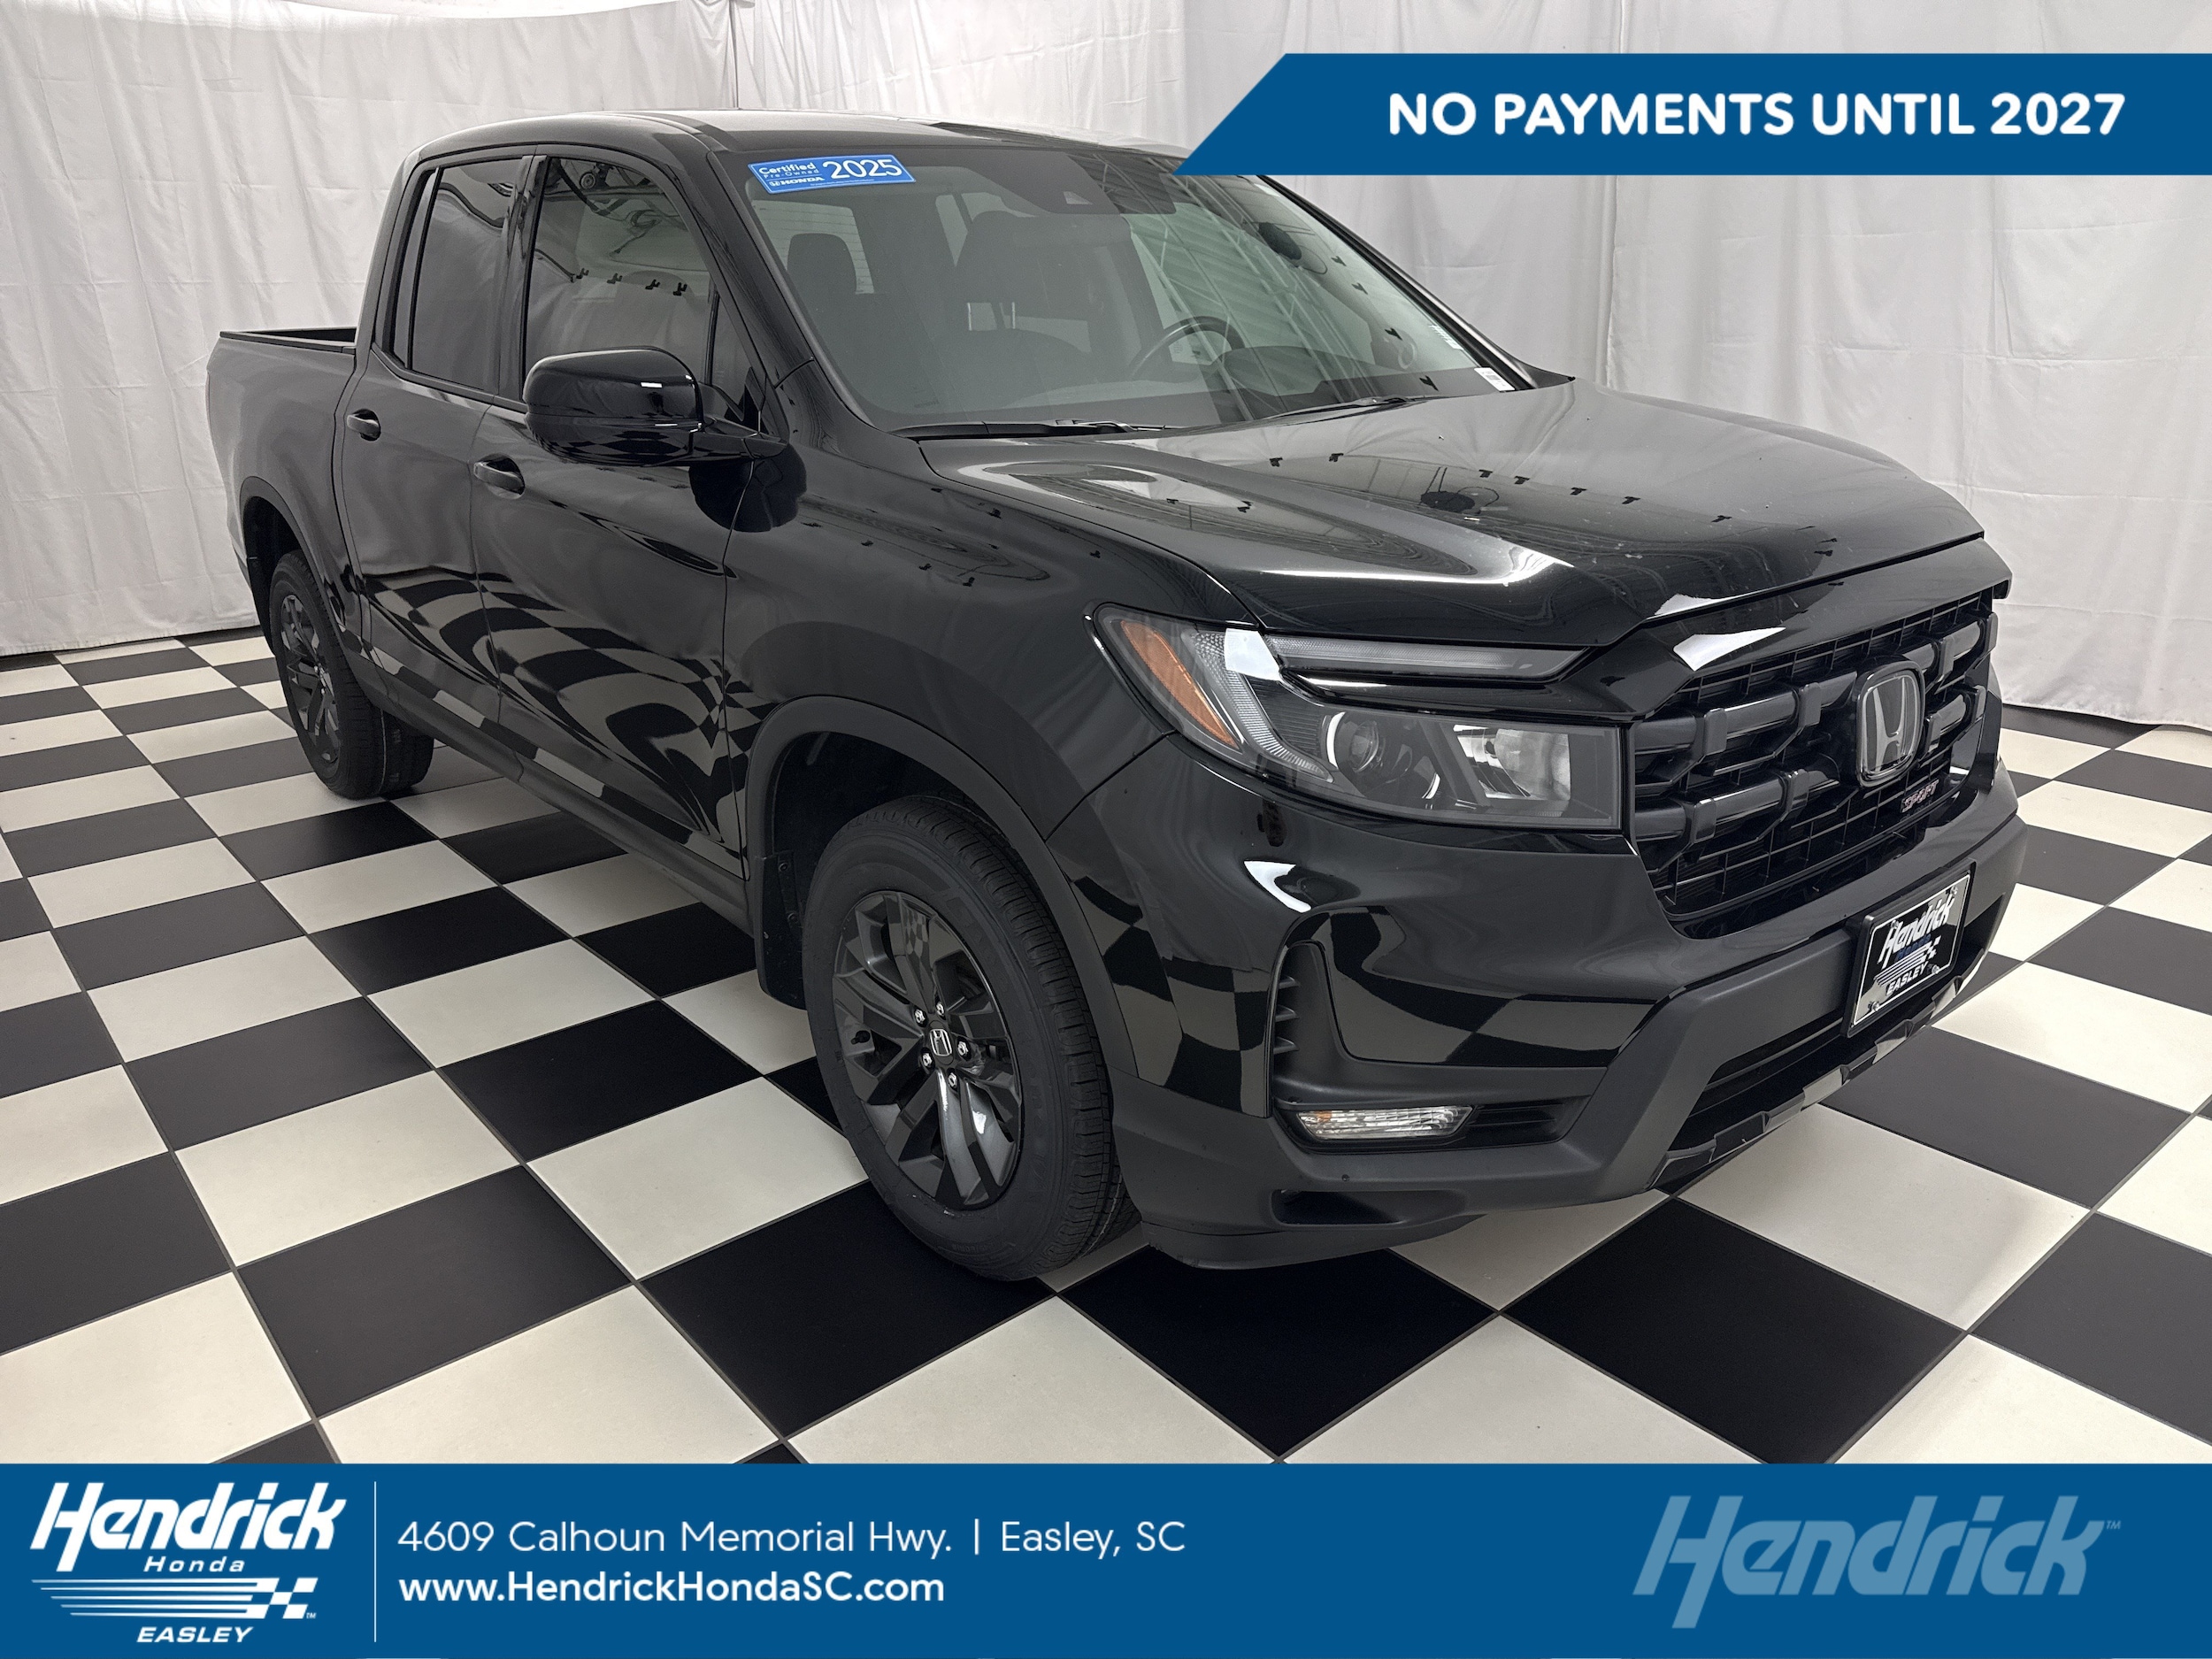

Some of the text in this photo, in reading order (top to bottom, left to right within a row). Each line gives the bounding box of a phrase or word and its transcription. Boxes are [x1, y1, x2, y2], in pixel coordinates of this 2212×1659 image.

[758, 159, 902, 180] Certified 2025
[763, 169, 819, 180] Pre-Owned
[1877, 892, 1955, 970] Hendrick
[1886, 962, 1929, 996] EASLEY
